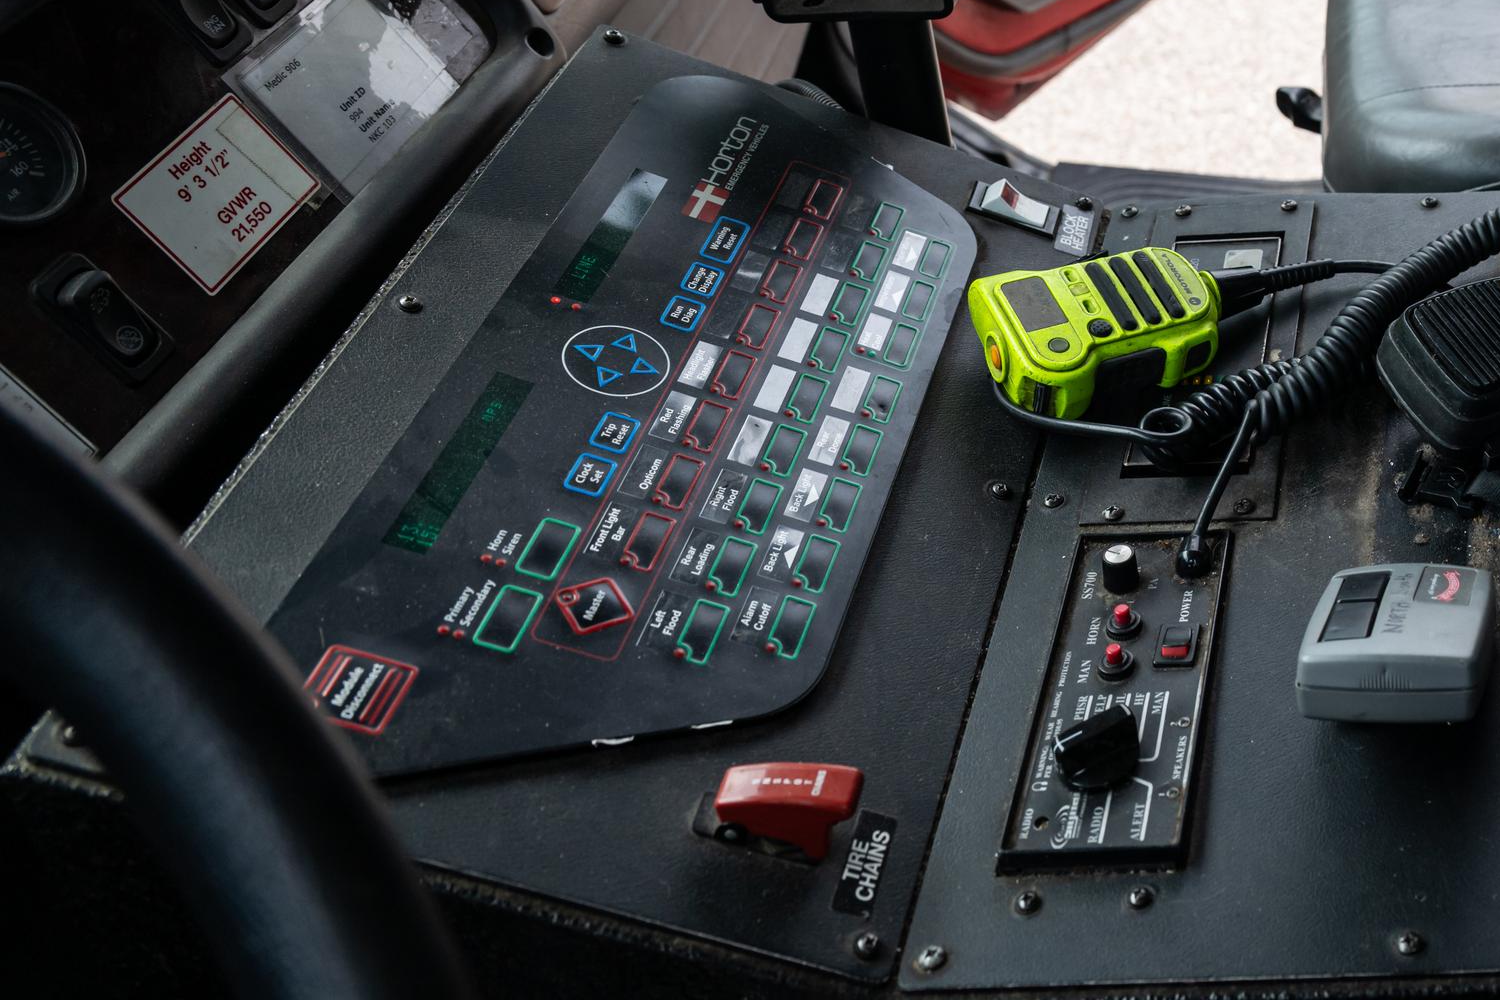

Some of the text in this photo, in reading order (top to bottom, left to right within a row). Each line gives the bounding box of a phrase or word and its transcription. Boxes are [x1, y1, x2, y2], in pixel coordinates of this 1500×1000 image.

[264, 58, 301, 92] Medic 906
[340, 87, 366, 112] Unit ID
[349, 107, 365, 123] 994
[359, 115, 376, 133] Unit
[368, 115, 397, 143] NKC 103
[168, 140, 212, 180] Height
[700, 116, 758, 187] Horton
[724, 123, 770, 191] EMERGENCY VEHICLES
[192, 174, 207, 189] 3
[217, 186, 257, 225] GVWR
[231, 201, 272, 243] 21,550
[1059, 213, 1079, 247] BLOCK
[1071, 215, 1089, 251] HEATER
[709, 225, 732, 251] Warning
[723, 233, 738, 251] Reset
[687, 267, 707, 290] Change
[697, 270, 718, 294] Display
[1161, 253, 1192, 296] MOTOROLA
[670, 305, 685, 319] Run
[681, 307, 698, 323] Diag
[683, 349, 707, 380] Headlight
[660, 407, 674, 424] Red
[668, 404, 690, 435] Flashing
[601, 423, 616, 438] Trip
[611, 424, 630, 446] Reset
[575, 462, 594, 484] Clock
[590, 469, 605, 485] Set
[639, 458, 663, 490] Opticom
[709, 486, 726, 507] Right
[722, 489, 739, 511] Flood
[788, 474, 813, 513] Back Light
[487, 529, 508, 551] Horn
[501, 532, 523, 556] Siren
[589, 507, 622, 553] Front Light
[611, 525, 626, 542] Bar
[680, 546, 697, 566] Rear
[691, 543, 716, 576] Loading
[763, 529, 790, 573] Back Light
[1081, 571, 1098, 601] SS700
[444, 585, 475, 623] Primary
[459, 579, 497, 628] Secondary
[582, 589, 607, 622] Master
[740, 599, 759, 627] Alarm
[753, 603, 772, 631] Cutoff
[1179, 590, 1194, 623] POWER
[650, 609, 667, 629] Left
[662, 609, 682, 636] Flood
[1086, 616, 1102, 646] HORN
[1050, 691, 1063, 718] HEARING
[1058, 651, 1073, 688] PROTECTION
[1077, 659, 1092, 684] MAN
[330, 667, 365, 707] Module
[340, 663, 385, 720] Disconnect
[1134, 692, 1146, 706] HF
[1073, 695, 1089, 721] PHSR
[1094, 694, 1108, 716] ELP
[1151, 691, 1165, 715] MAN
[1172, 735, 1188, 780] SPEAKERS
[1019, 808, 1034, 840] RADIO
[1087, 806, 1104, 844] RADIO
[1129, 802, 1146, 842] ALERT
[841, 838, 869, 881] TIRE
[855, 829, 890, 902] CHAINS
